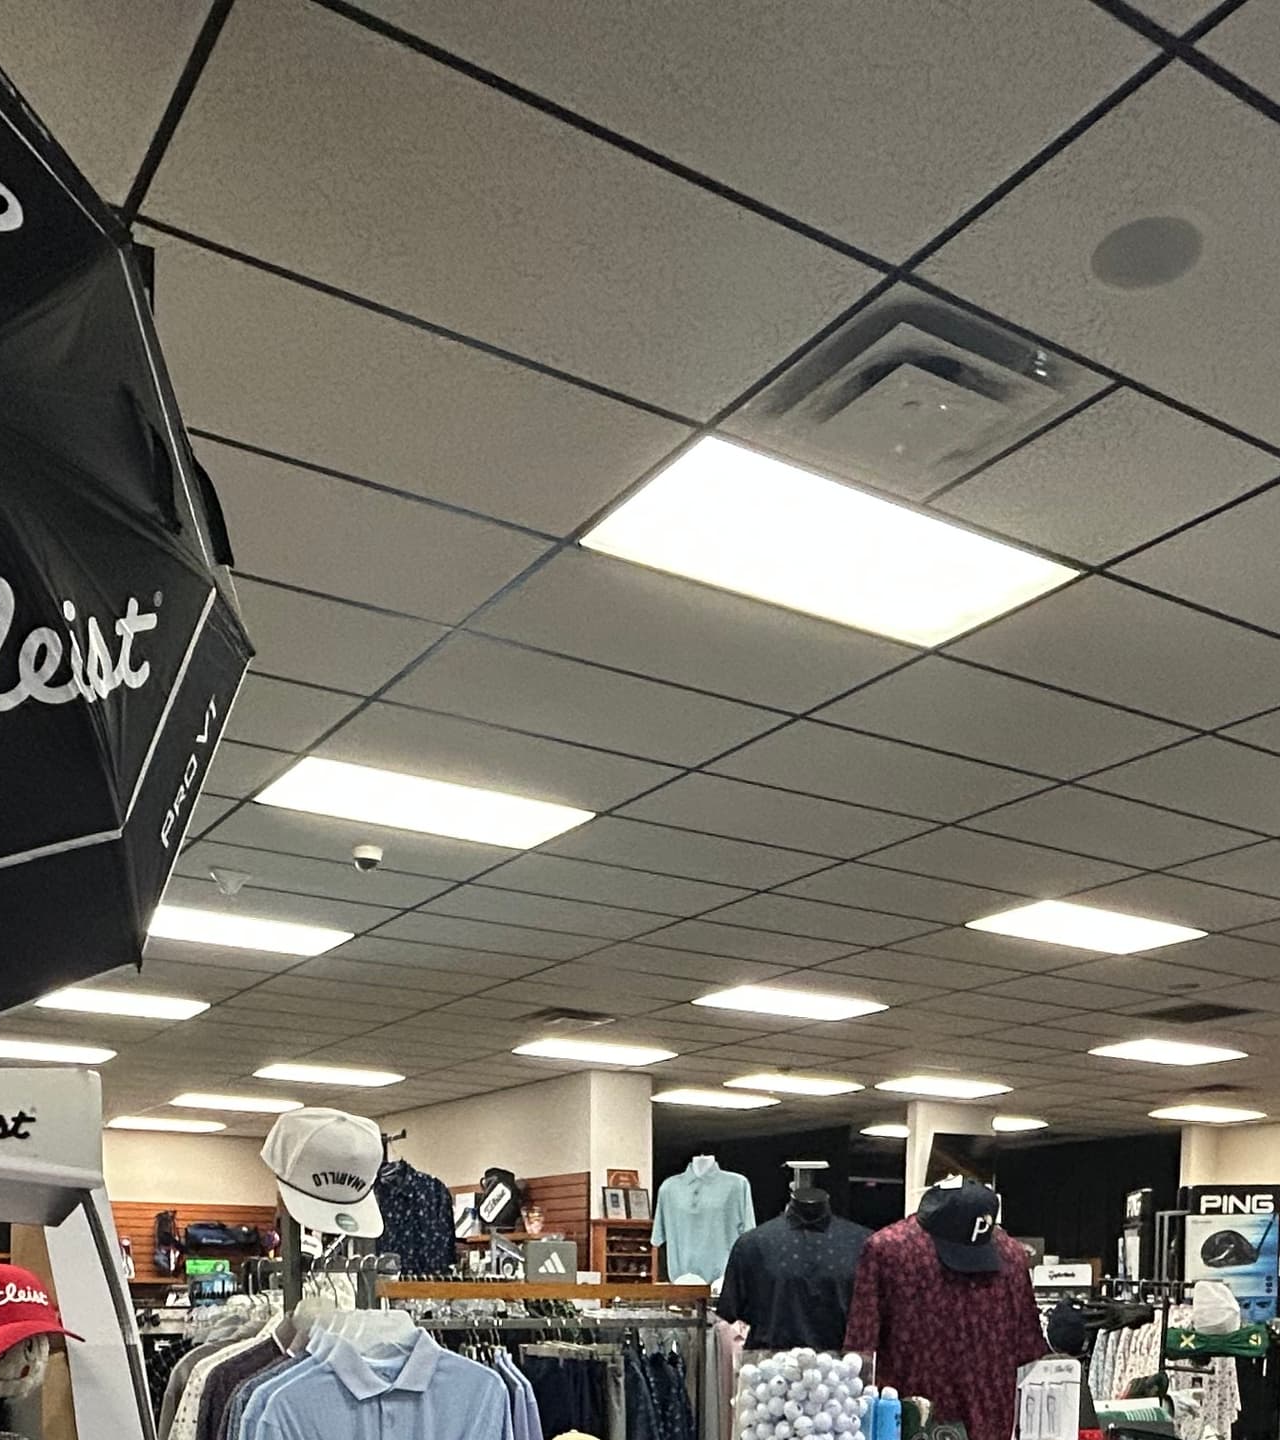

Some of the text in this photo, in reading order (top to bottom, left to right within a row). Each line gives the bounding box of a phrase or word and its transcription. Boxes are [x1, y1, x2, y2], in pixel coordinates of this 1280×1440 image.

[161, 700, 217, 849] PRO V1
[1199, 1194, 1275, 1215] PING
